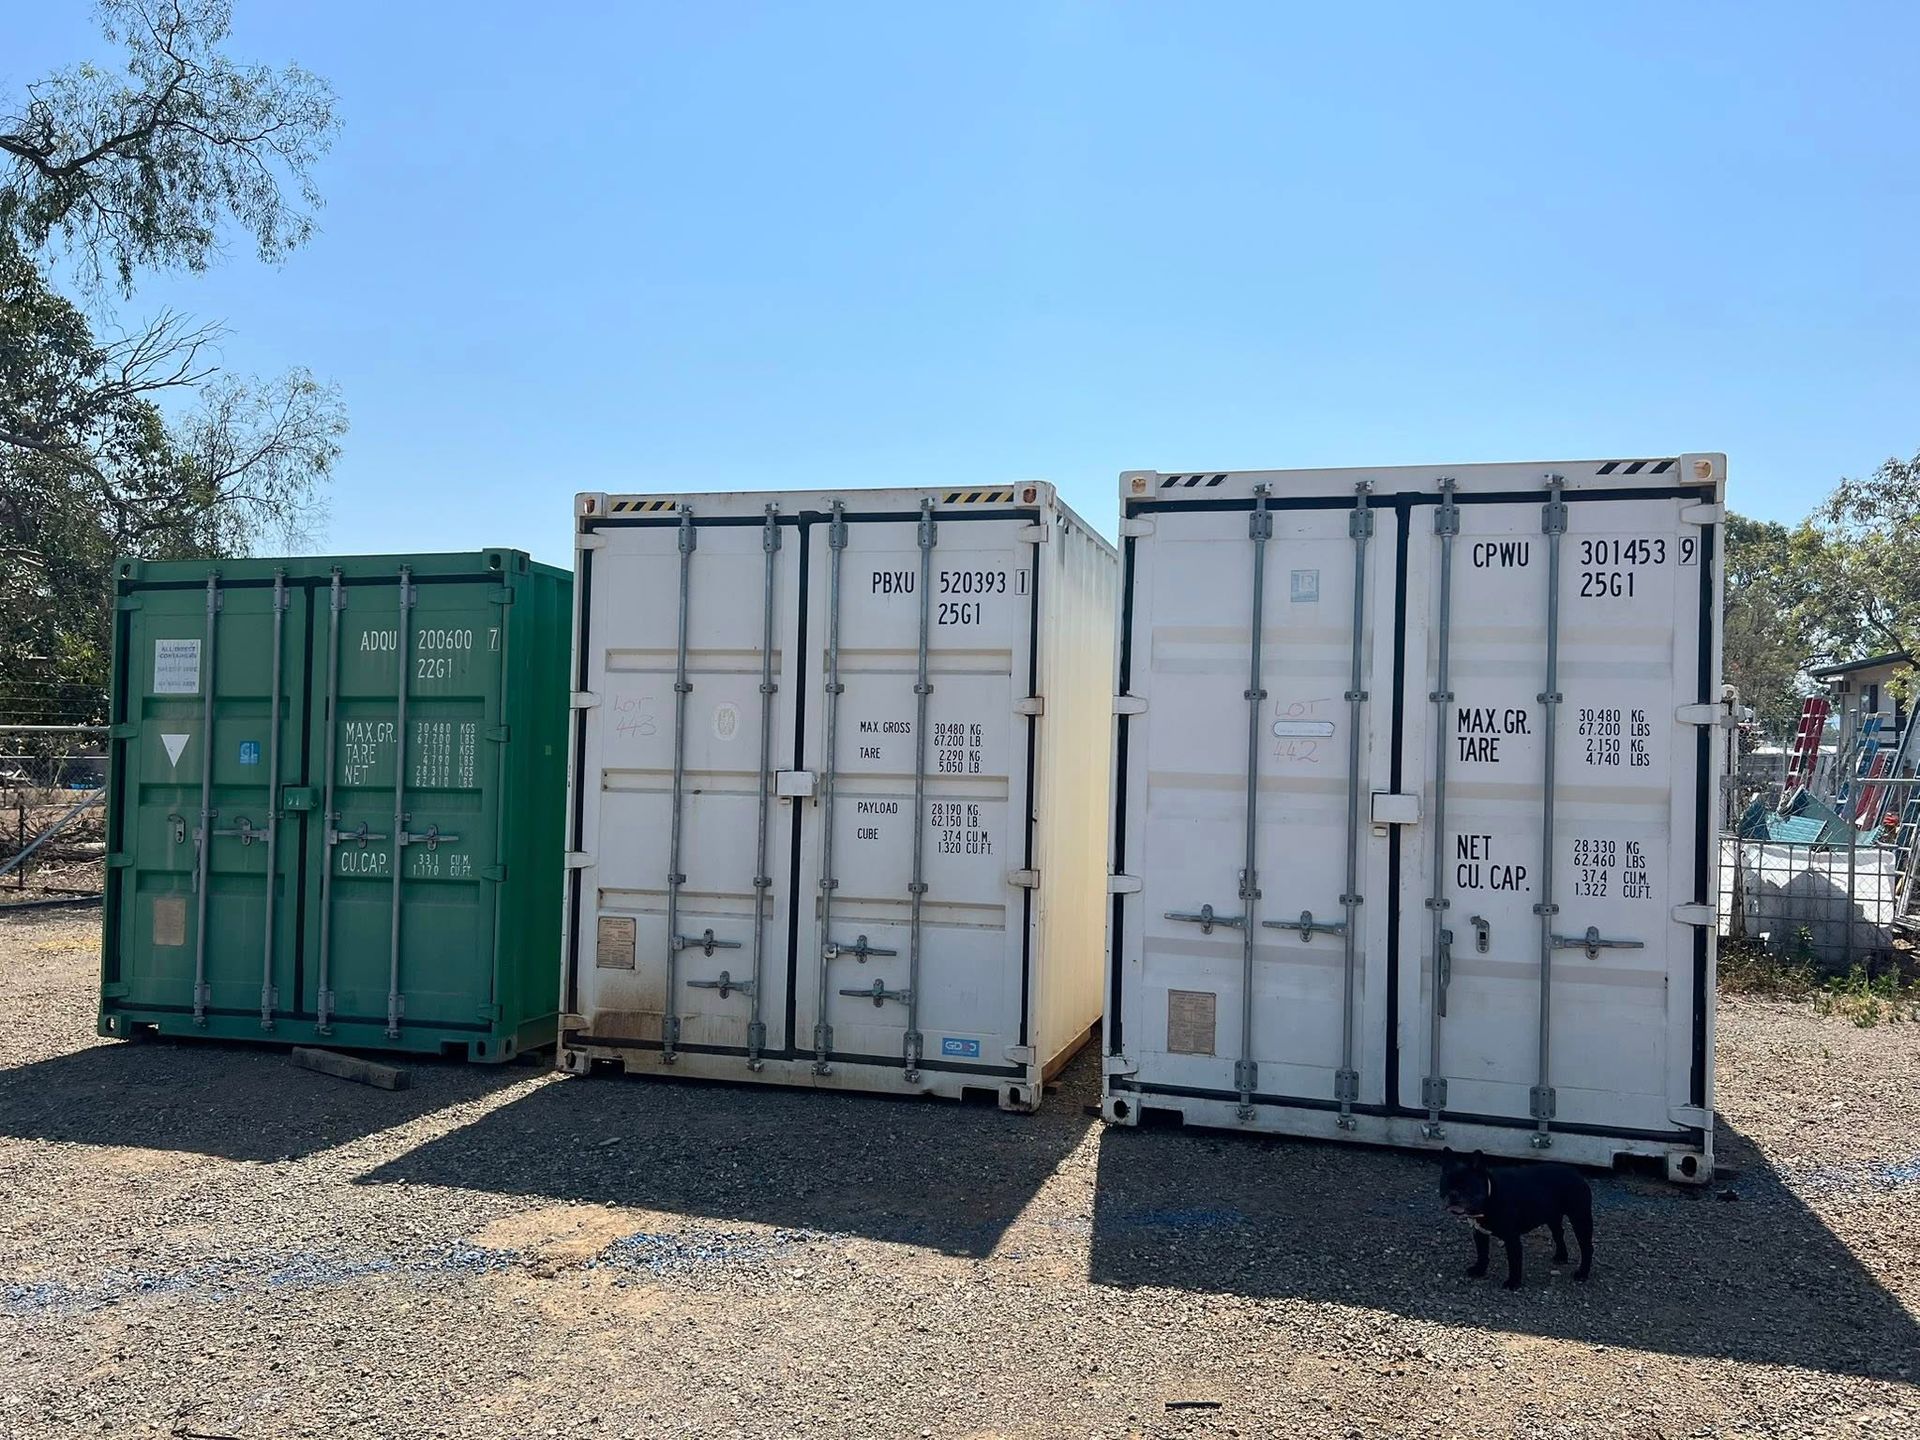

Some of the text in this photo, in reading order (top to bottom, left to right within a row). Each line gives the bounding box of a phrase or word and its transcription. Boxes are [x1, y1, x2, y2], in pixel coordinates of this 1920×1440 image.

[1473, 538, 1695, 568] CPWU 301453 9
[872, 571, 915, 594] PBXU
[940, 571, 1006, 594] 520393
[1580, 572, 1634, 598] 25G1
[938, 602, 981, 625] 25G1
[360, 629, 498, 651] ADQU 200600 7
[417, 658, 452, 679] 22G1
[1274, 698, 1333, 717] LOT
[1579, 709, 1621, 722] 30.480
[1631, 710, 1645, 722] KG
[460, 723, 476, 734] KGS
[615, 714, 657, 738] 443
[883, 721, 911, 734] GROSS
[934, 723, 964, 735] 30.480
[970, 724, 985, 736] KG.
[1578, 723, 1650, 736] 67.200 LBS
[459, 734, 476, 745] LBS
[934, 735, 983, 748] 67.200 LB.
[346, 743, 377, 764] TARE
[459, 745, 475, 756] KGS
[860, 747, 983, 762] TARE 2.290 KG.
[1273, 739, 1319, 763] 442
[1458, 737, 1644, 762] TARE 2.150 KG
[459, 755, 475, 767] LBS
[1585, 752, 1650, 767] 4.740 LBS
[344, 765, 369, 785] NET
[458, 766, 474, 777] KGS
[939, 761, 982, 774] 5.050 LB.
[857, 802, 981, 816] PAYLOAD 28.190 KG.
[931, 815, 981, 828] 62.150 LB.
[857, 828, 991, 843] CUBE 37.4 CU.M.
[937, 842, 993, 855] 1.320 CU.FT.
[1457, 835, 1640, 860] NET 28.330 KG
[419, 853, 439, 865] 33.1
[1574, 853, 1646, 869] 62.460 LBS
[412, 864, 439, 876] 1.170
[1457, 864, 1649, 892] CU. CAP. 37.4 CU.M.
[1575, 883, 1652, 899] 1.322 CU.FT.
